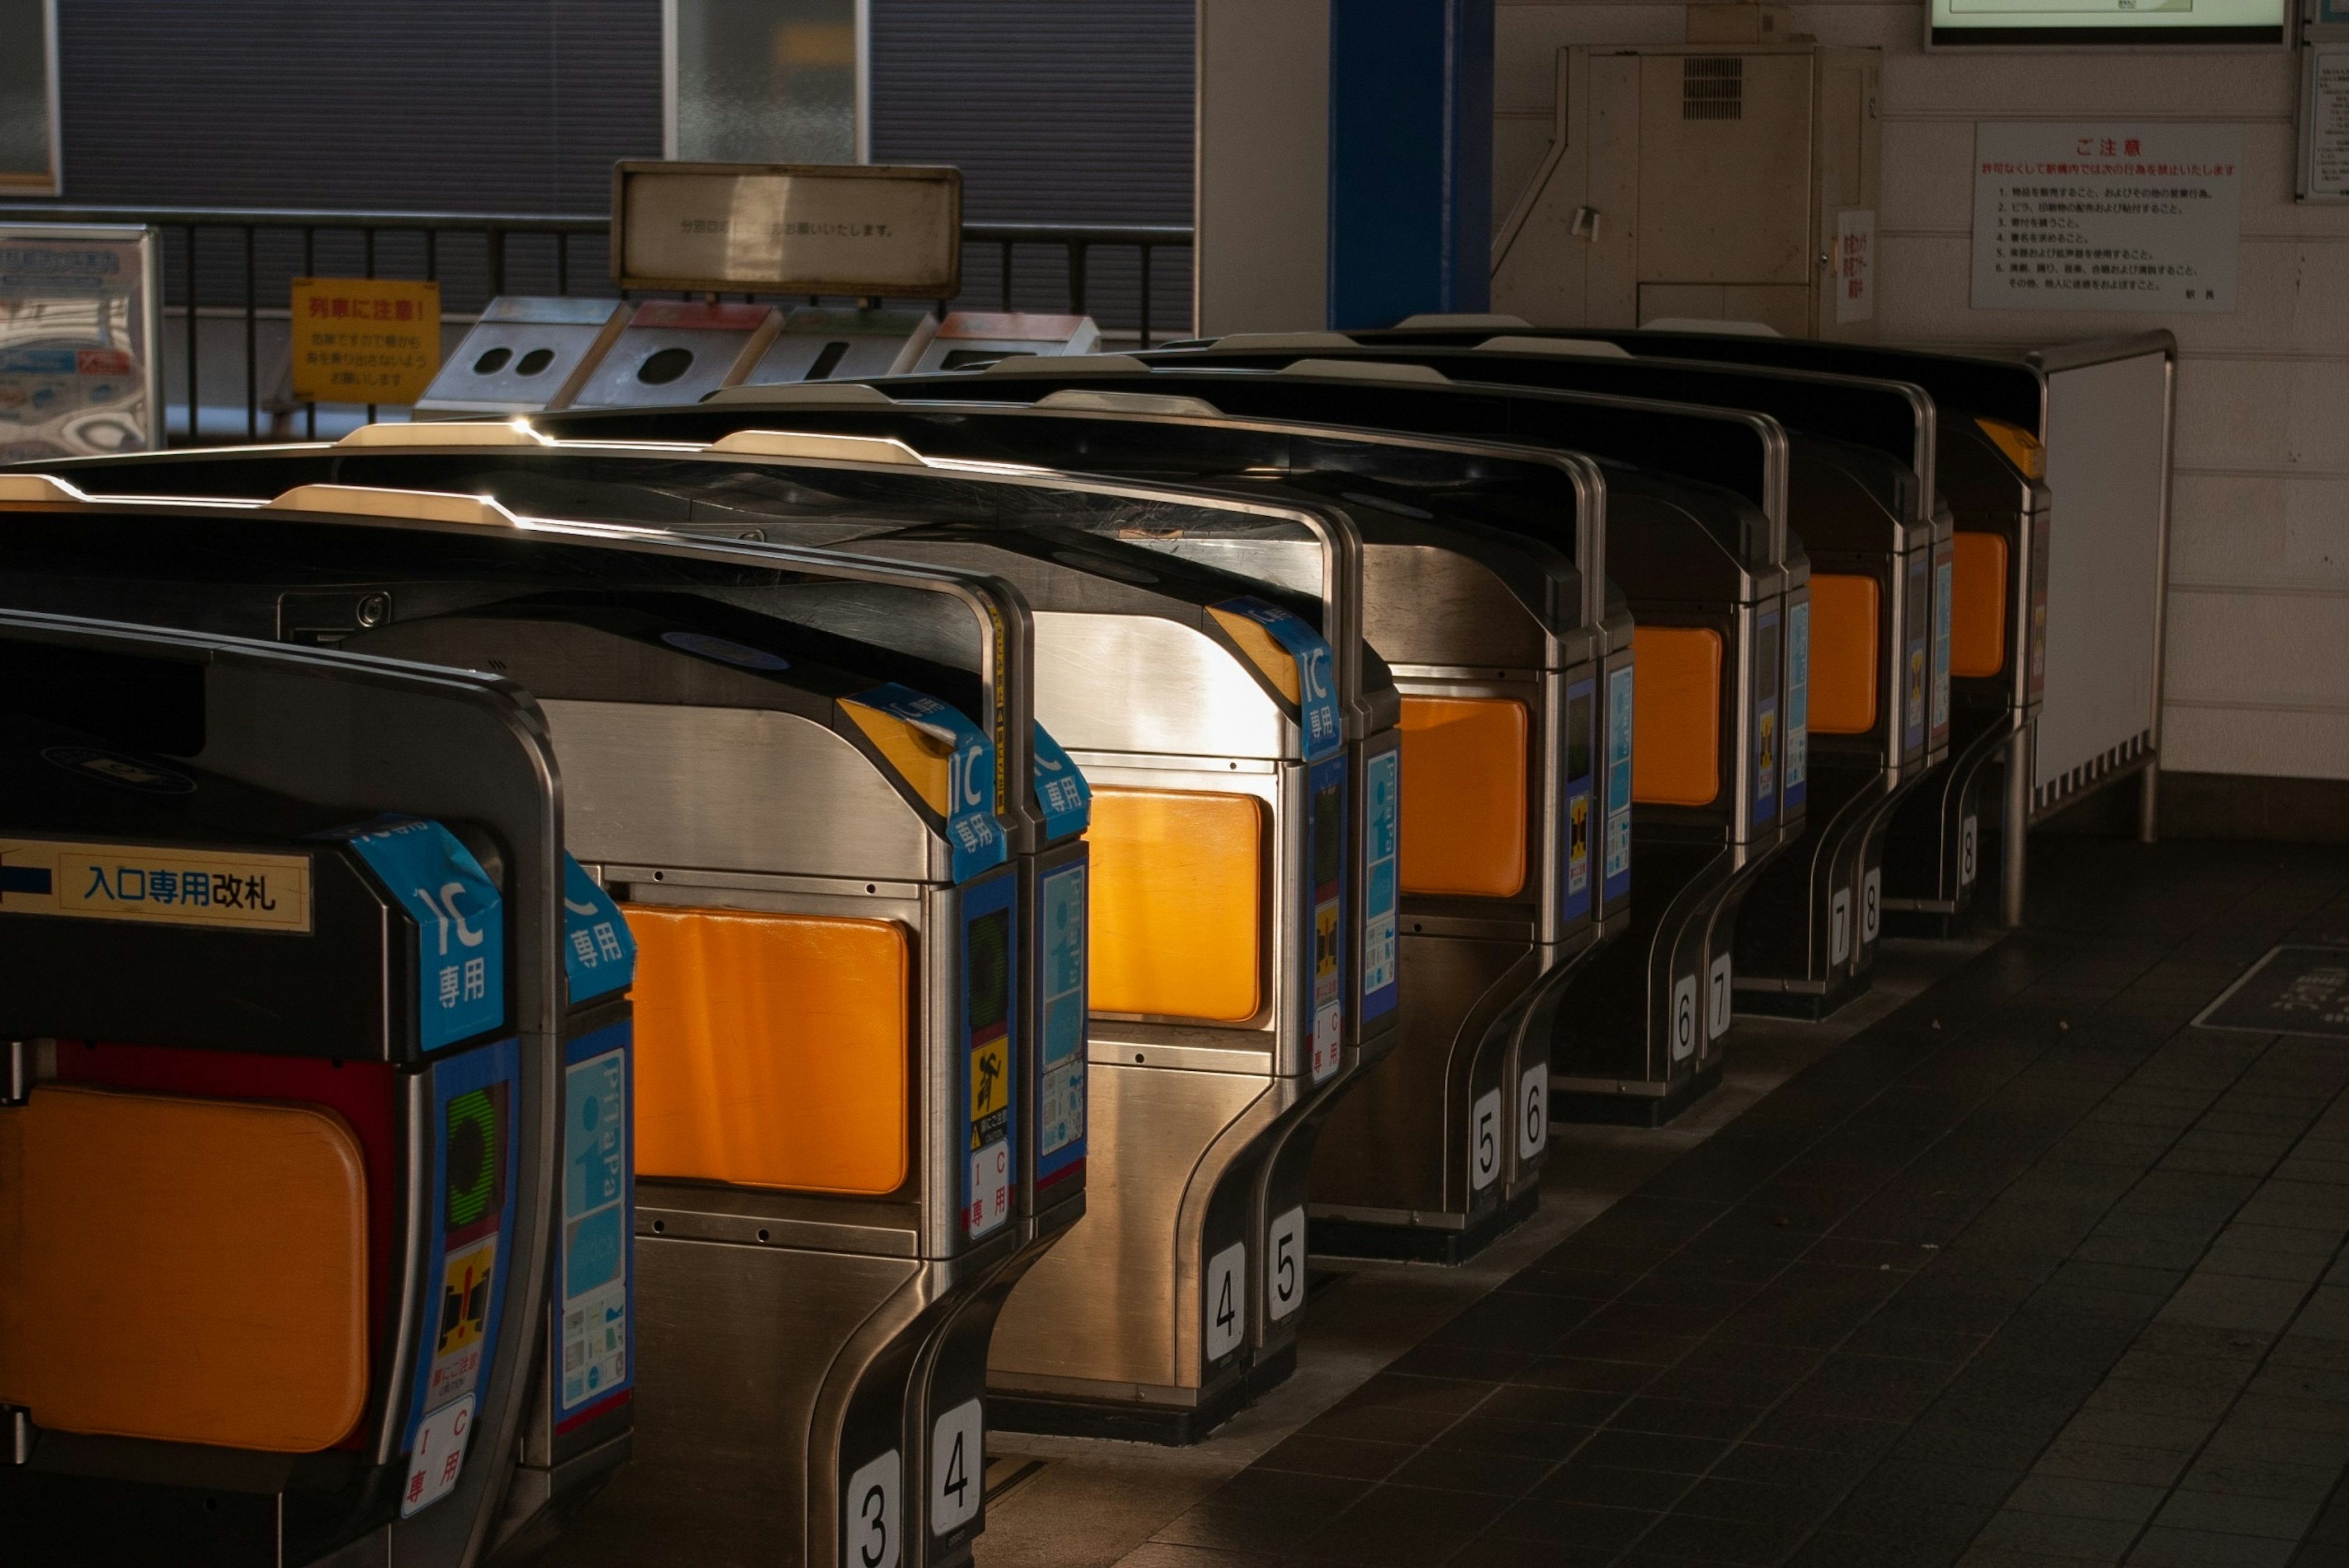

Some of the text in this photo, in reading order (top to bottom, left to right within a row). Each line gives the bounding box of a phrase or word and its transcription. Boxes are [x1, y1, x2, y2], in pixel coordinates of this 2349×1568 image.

[2076, 138, 2142, 157] ご注意
[1302, 648, 1326, 703] IC
[1310, 706, 1334, 739] 専用
[954, 745, 984, 814] IC
[1045, 775, 1082, 813] 専用
[956, 813, 993, 854] 専用
[1965, 831, 1972, 873] 8
[84, 866, 276, 911] 入口専用改札
[1868, 884, 1875, 931] 8
[570, 921, 623, 969] 専用
[1836, 904, 1845, 953] 7
[439, 956, 485, 1008] 専用
[1715, 972, 1724, 1026] 7
[1679, 994, 1690, 1046] 6
[1314, 1042, 1337, 1074] 専用
[603, 1066, 619, 1197] PiTaPa
[1527, 1085, 1540, 1144] 6
[1480, 1111, 1493, 1174] 5
[972, 1186, 1006, 1226] 専用
[1278, 1232, 1294, 1301] 5
[1217, 1270, 1235, 1336] 4
[407, 1450, 461, 1503] 専用
[944, 1430, 968, 1507] 4
[861, 1484, 886, 1568] 3
